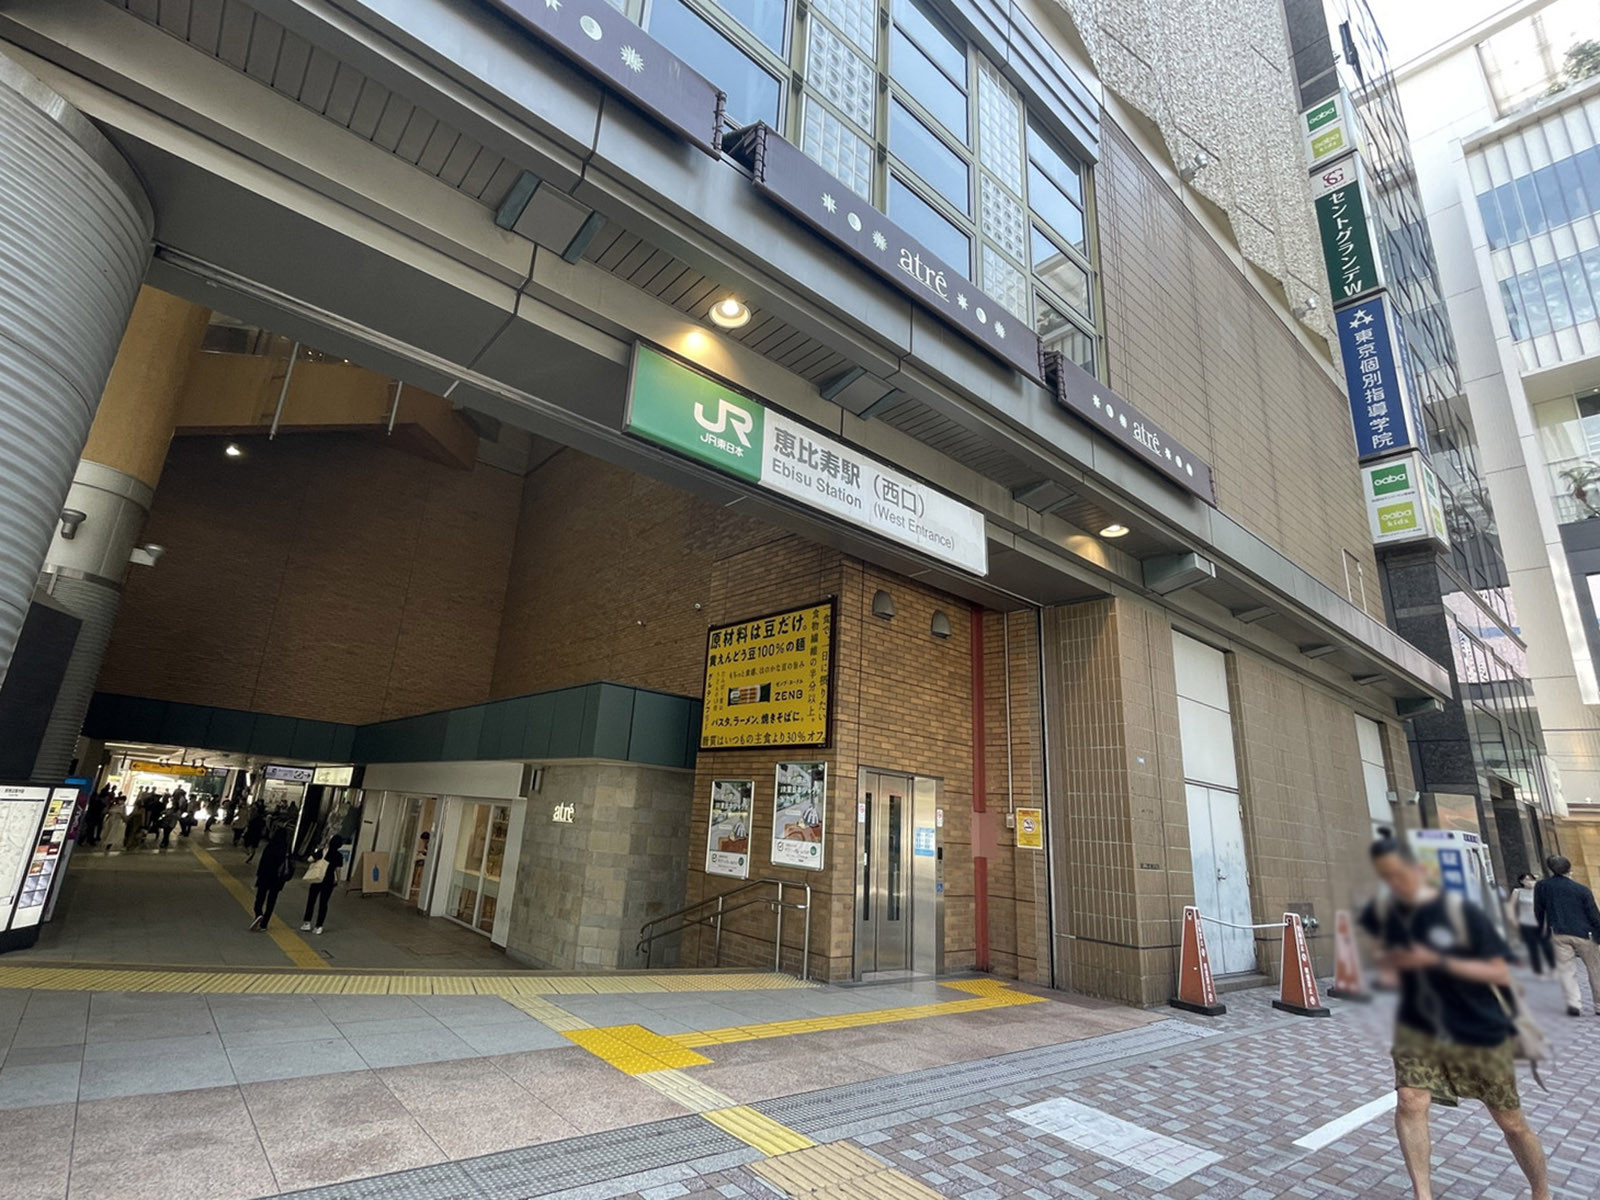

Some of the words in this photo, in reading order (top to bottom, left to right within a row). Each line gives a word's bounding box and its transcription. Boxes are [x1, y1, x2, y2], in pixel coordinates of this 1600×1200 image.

[1329, 191, 1363, 296] セントグランデW
[694, 398, 753, 449] JR
[1354, 328, 1394, 449] 東京個別指導学院
[700, 433, 745, 457] JR東日本
[773, 426, 861, 489] 恵比寿駅
[873, 474, 925, 519] （西口）
[772, 457, 812, 487] Ebisu
[815, 477, 862, 509] Station
[873, 502, 905, 528] (West
[908, 518, 955, 551] Entrance)
[710, 614, 808, 650] 原材料は豆だけ。
[774, 689, 804, 701] ZENB
